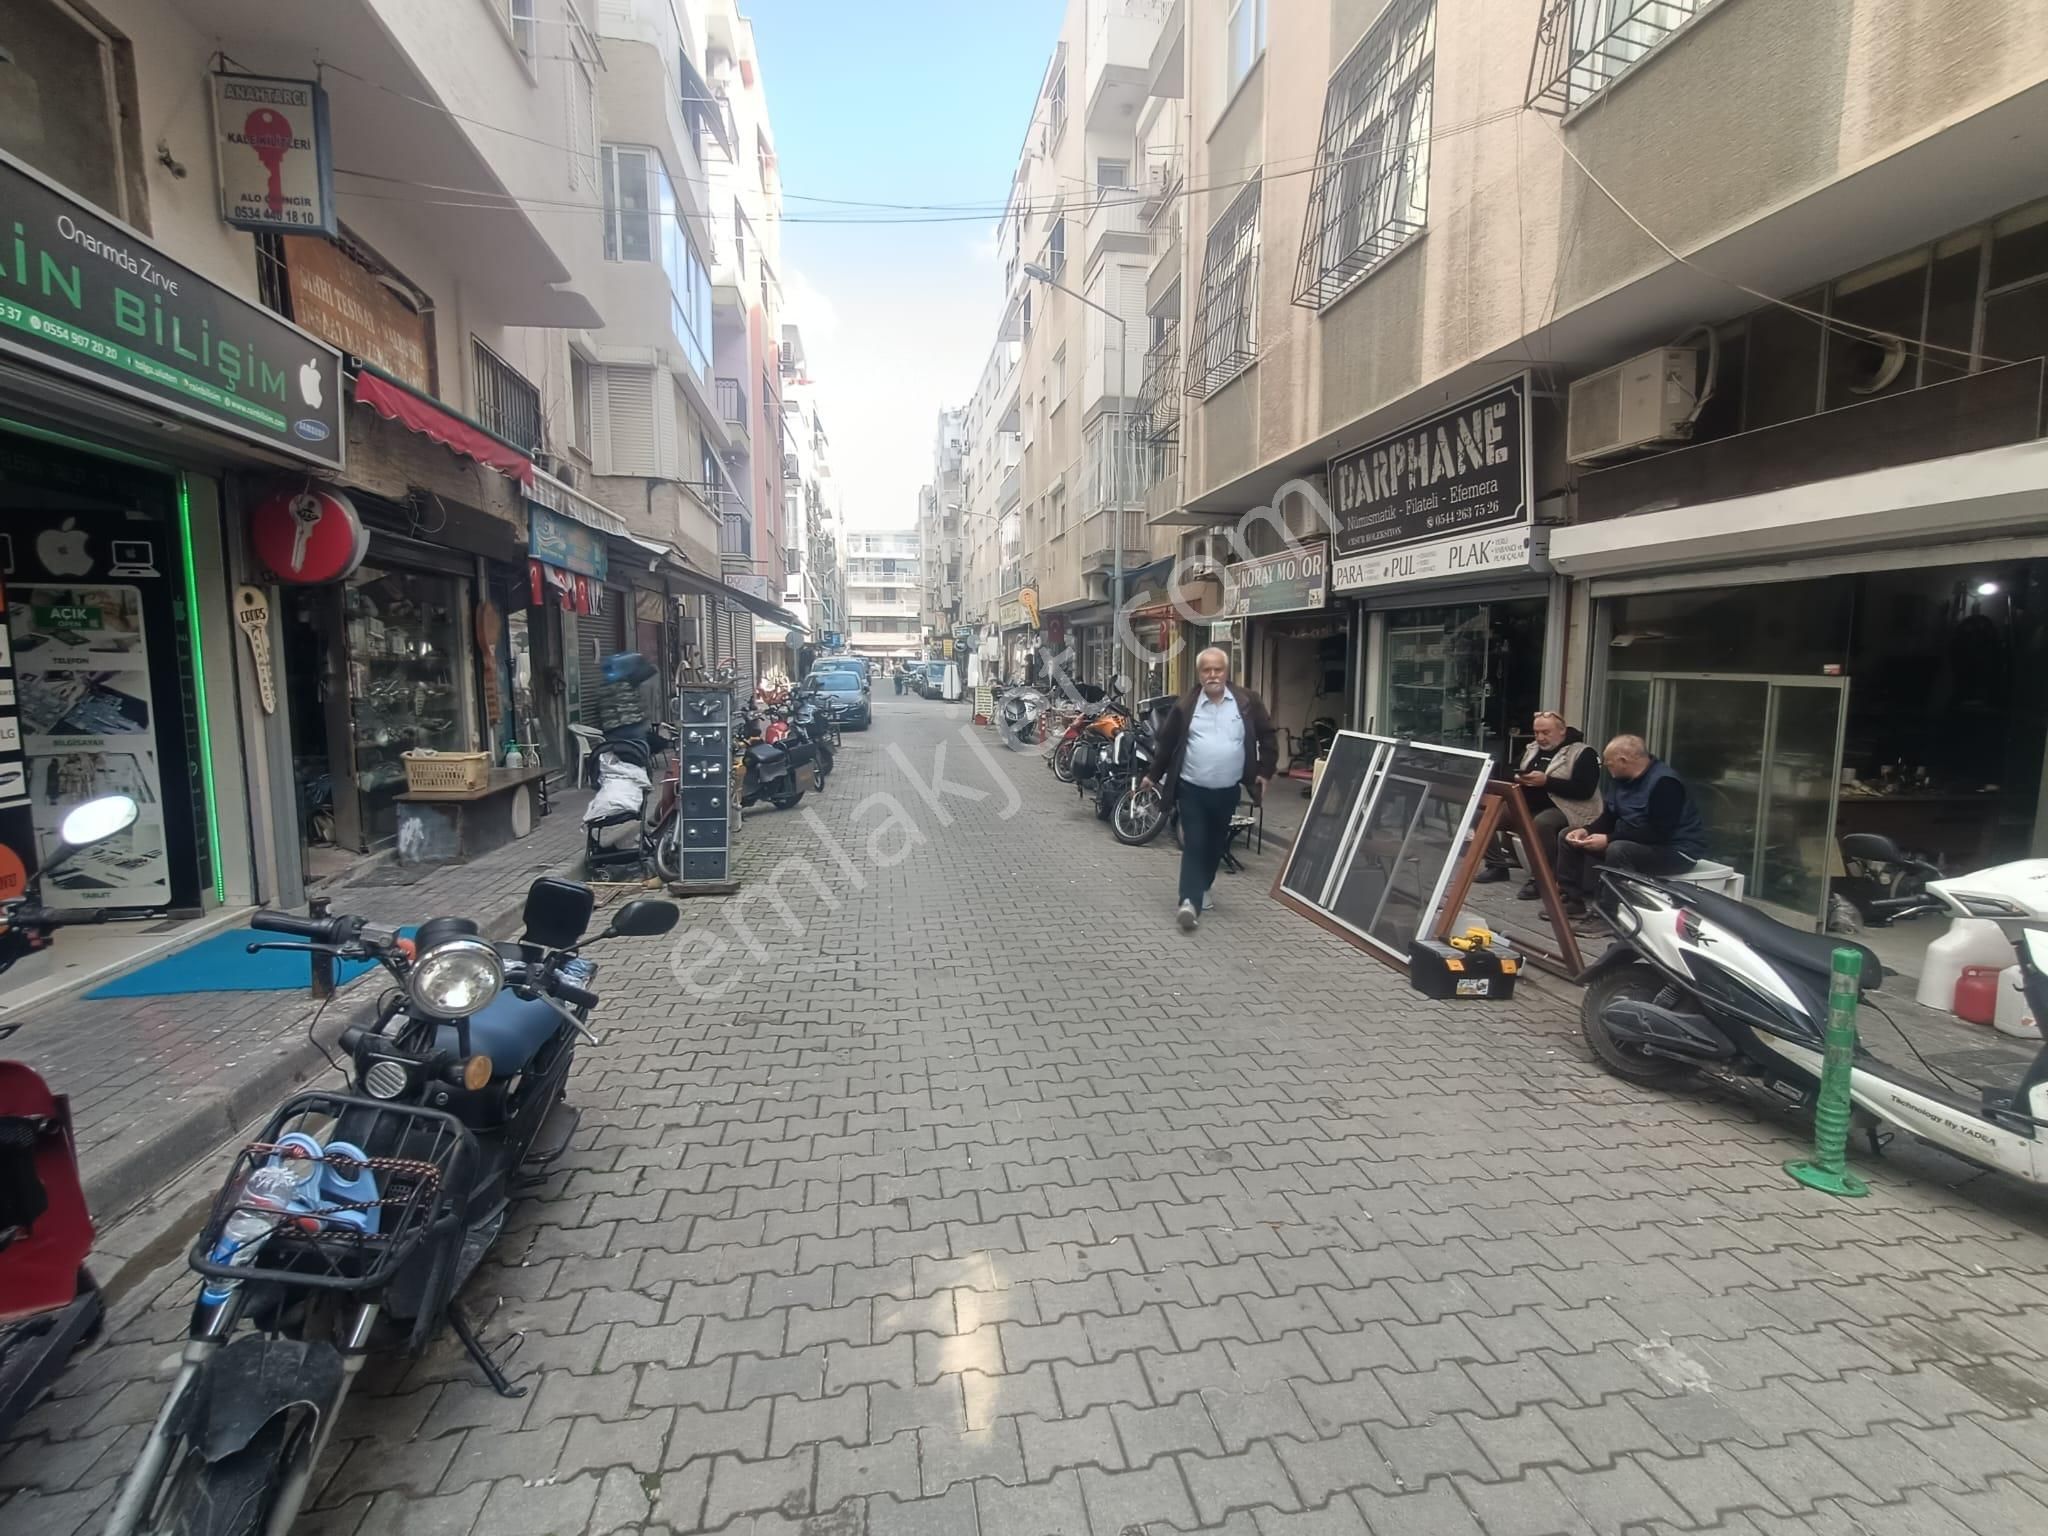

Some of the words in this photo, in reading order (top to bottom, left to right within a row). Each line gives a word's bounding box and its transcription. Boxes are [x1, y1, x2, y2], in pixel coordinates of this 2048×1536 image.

[224, 84, 308, 106] ANAHTARCI
[240, 193, 261, 203] ALO
[235, 205, 260, 219] 0534
[287, 209, 298, 222] 18
[302, 212, 314, 224] 10
[0, 222, 81, 310] İN
[115, 287, 285, 402] BİLİŞİM
[43, 321, 69, 340] 0554
[71, 332, 89, 348] 907
[91, 340, 104, 353] 20
[106, 346, 117, 359] 20
[1338, 402, 1509, 512] DARPHANE
[1405, 492, 1439, 516] Filateli
[1450, 479, 1498, 504] Efemera
[1435, 513, 1454, 527] 0544
[1456, 509, 1472, 523] 263
[1474, 505, 1485, 517] 75
[1487, 500, 1499, 514] 26
[1449, 540, 1491, 568] PLAK
[1241, 564, 1274, 588] KORAY
[1336, 564, 1364, 586] PARA
[1391, 555, 1416, 578] PUL
[50, 608, 87, 622] AÇIK
[53, 657, 89, 665] TELEFON
[1, 729, 16, 740] LG
[1891, 1094, 1942, 1123] Technology
[1945, 1119, 1958, 1130] By
